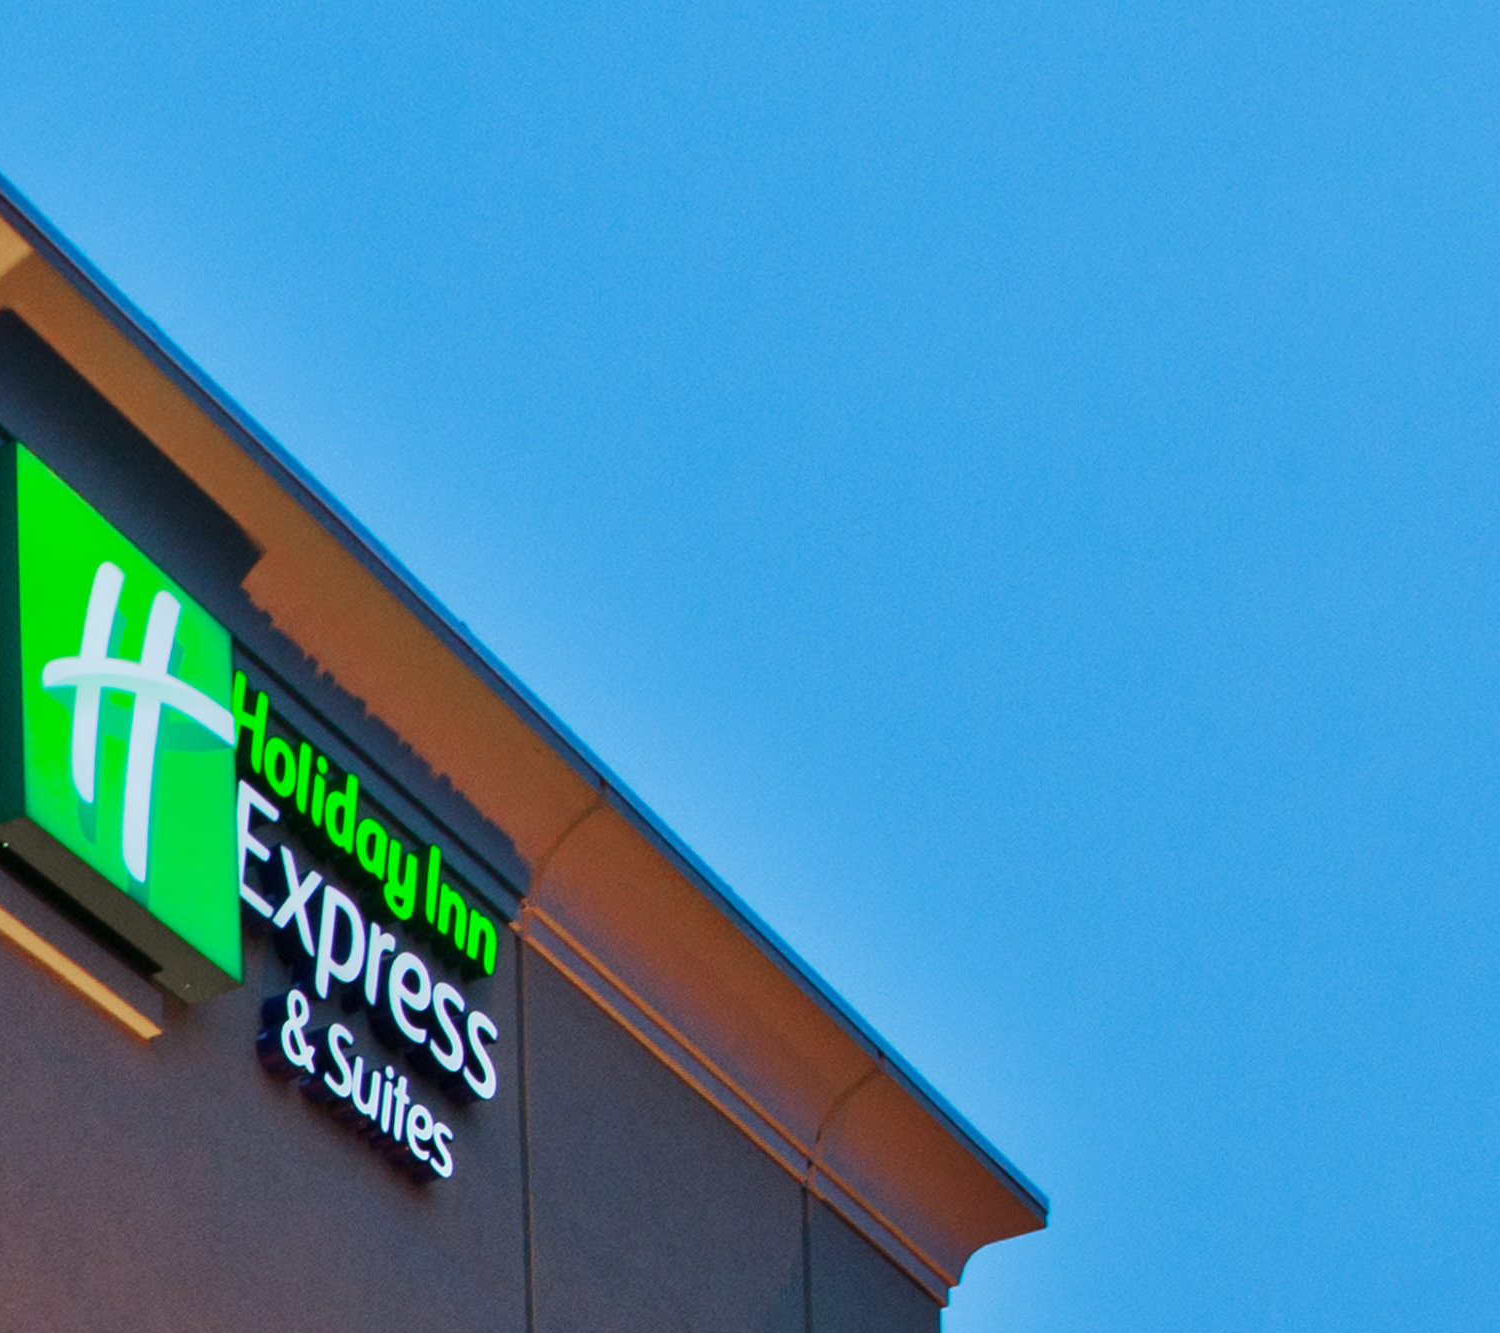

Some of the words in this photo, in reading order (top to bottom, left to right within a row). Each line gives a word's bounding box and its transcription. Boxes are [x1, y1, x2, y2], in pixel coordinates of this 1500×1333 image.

[232, 669, 418, 921] Holiday
[425, 844, 497, 977] Inn
[236, 779, 498, 1099] Express
[280, 988, 316, 1074] &
[323, 1022, 454, 1178] Suites
